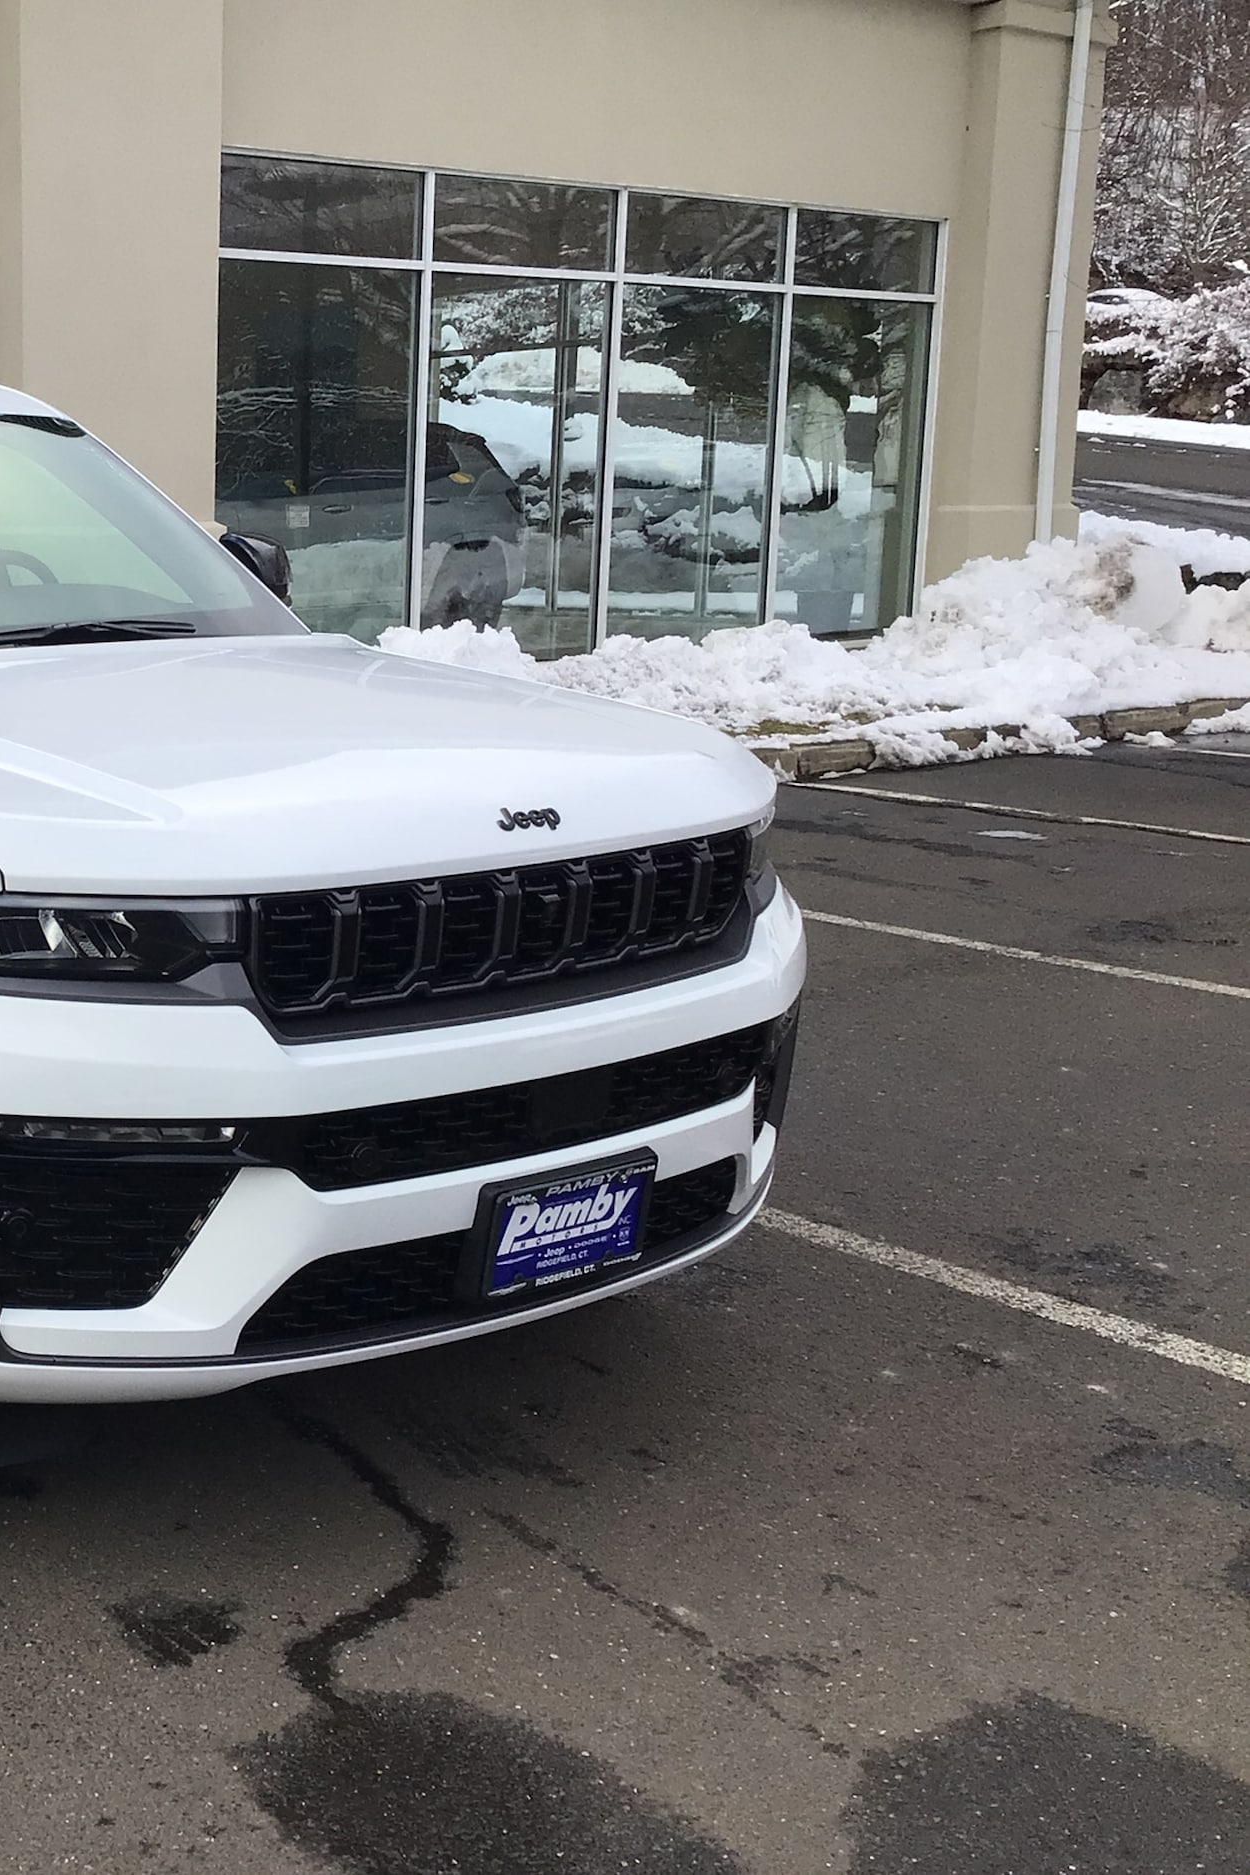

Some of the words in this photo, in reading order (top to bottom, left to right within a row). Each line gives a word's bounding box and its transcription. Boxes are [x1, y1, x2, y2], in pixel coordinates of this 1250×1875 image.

[496, 807, 561, 832] Jeep
[496, 1183, 639, 1257] Pamby
[519, 1223, 599, 1249] MOTORS
[544, 1246, 566, 1258] Jeep
